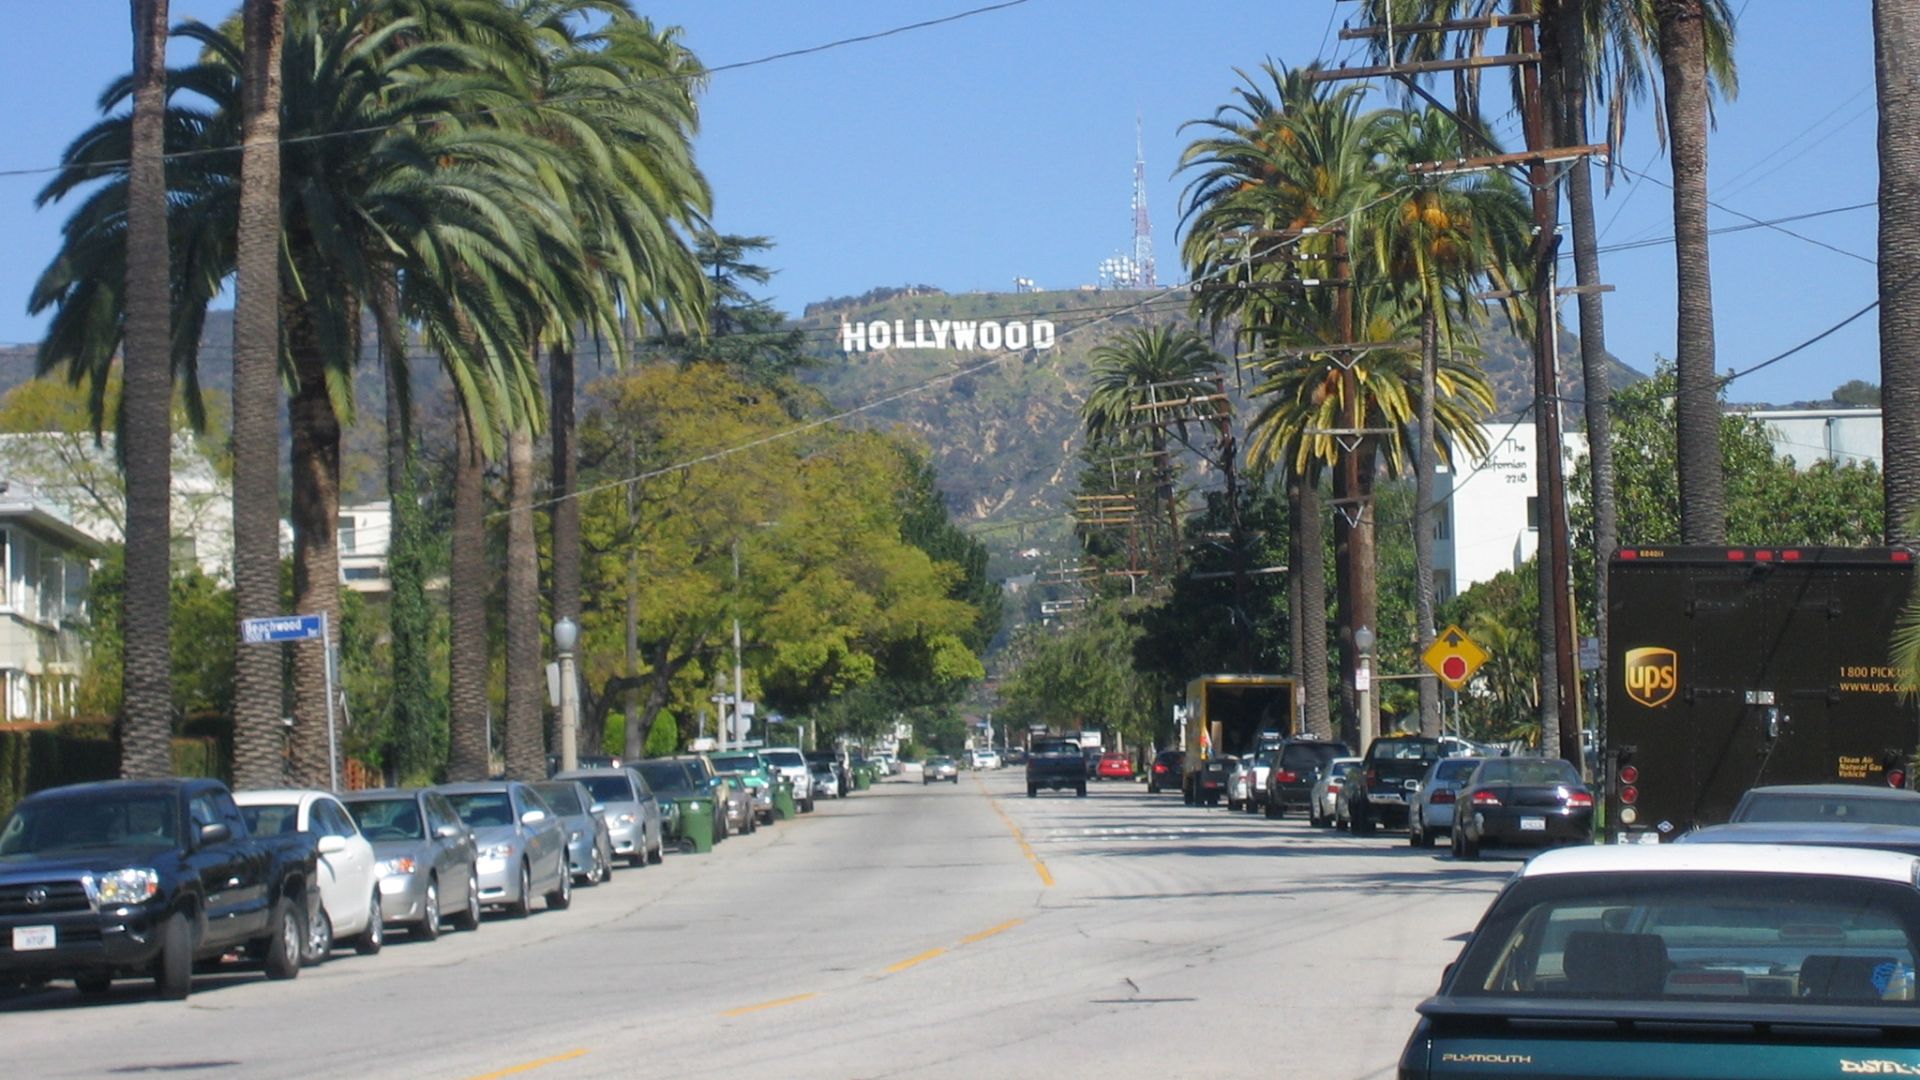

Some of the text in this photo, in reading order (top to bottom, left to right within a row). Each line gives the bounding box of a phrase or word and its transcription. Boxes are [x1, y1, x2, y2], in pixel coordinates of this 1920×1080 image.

[842, 319, 1055, 352] HOLLYWOOD
[1505, 438, 1526, 453] The
[244, 619, 302, 634] Beachwood
[1840, 666, 1845, 677] 1
[1847, 666, 1868, 678] 800
[1870, 666, 1894, 678] PICK
[1629, 665, 1673, 698] ups
[1839, 756, 1860, 764] Clean
[1442, 1053, 1531, 1063] PLYMOUTH
